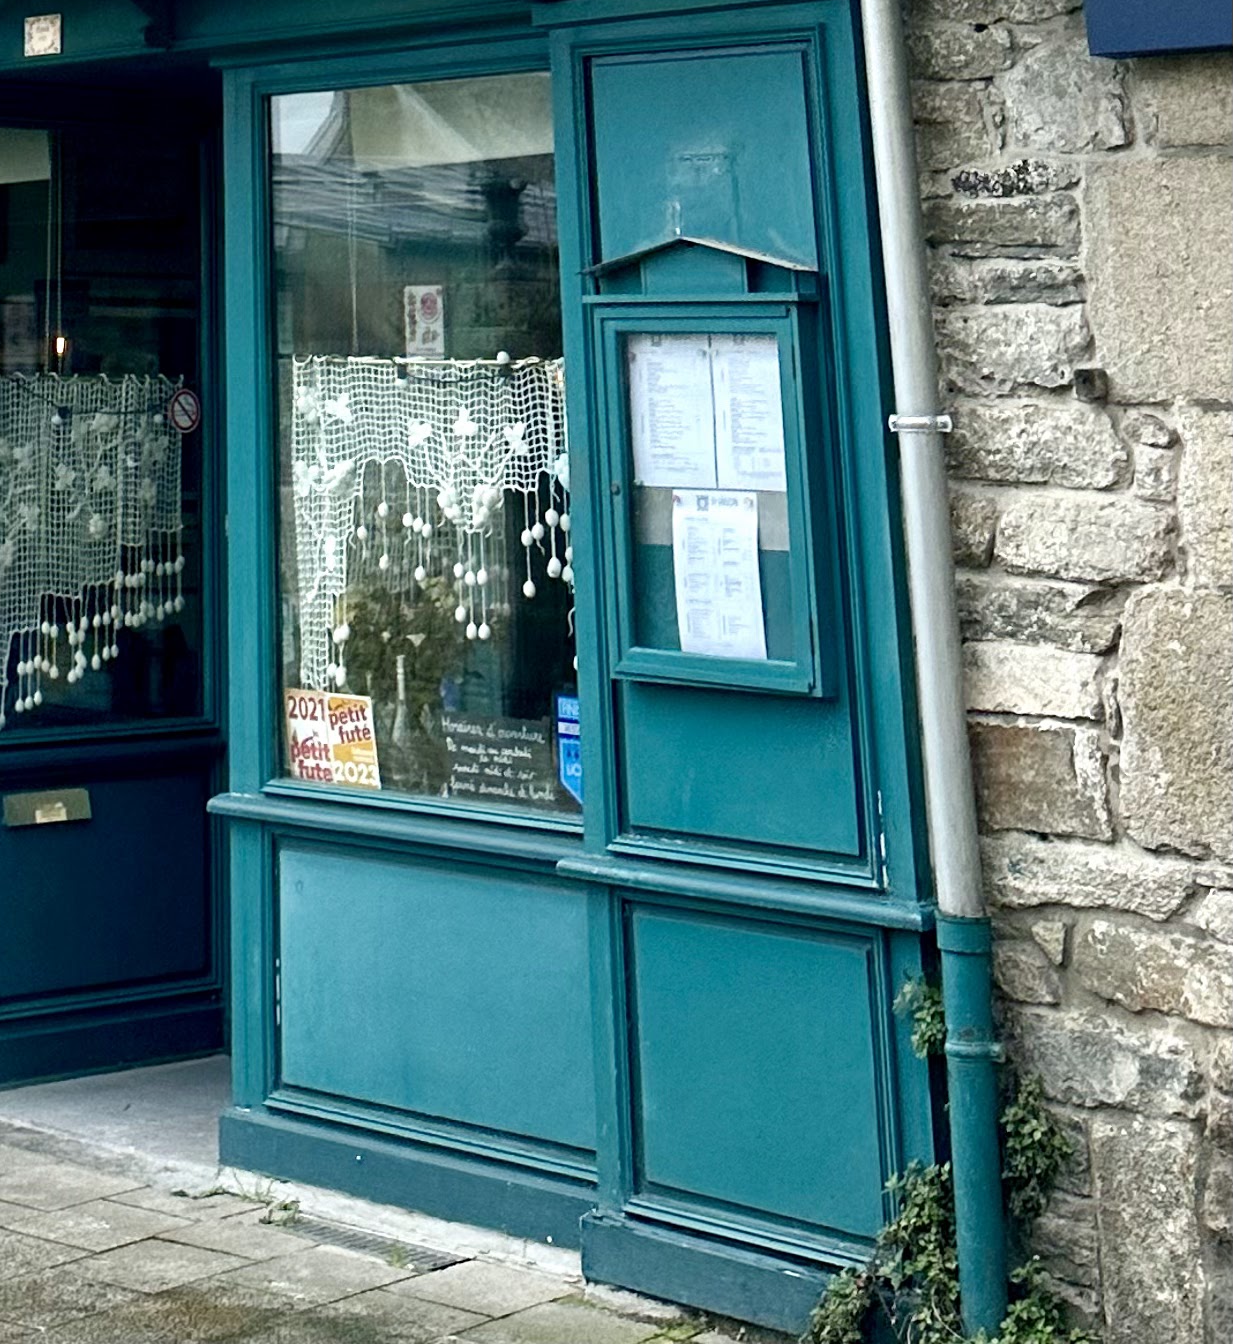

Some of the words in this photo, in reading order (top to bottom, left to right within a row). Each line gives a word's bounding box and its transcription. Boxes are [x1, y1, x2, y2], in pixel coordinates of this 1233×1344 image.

[287, 695, 326, 722] 2021
[328, 704, 368, 730] petit
[291, 741, 331, 763] petit
[332, 760, 380, 787] 2023
